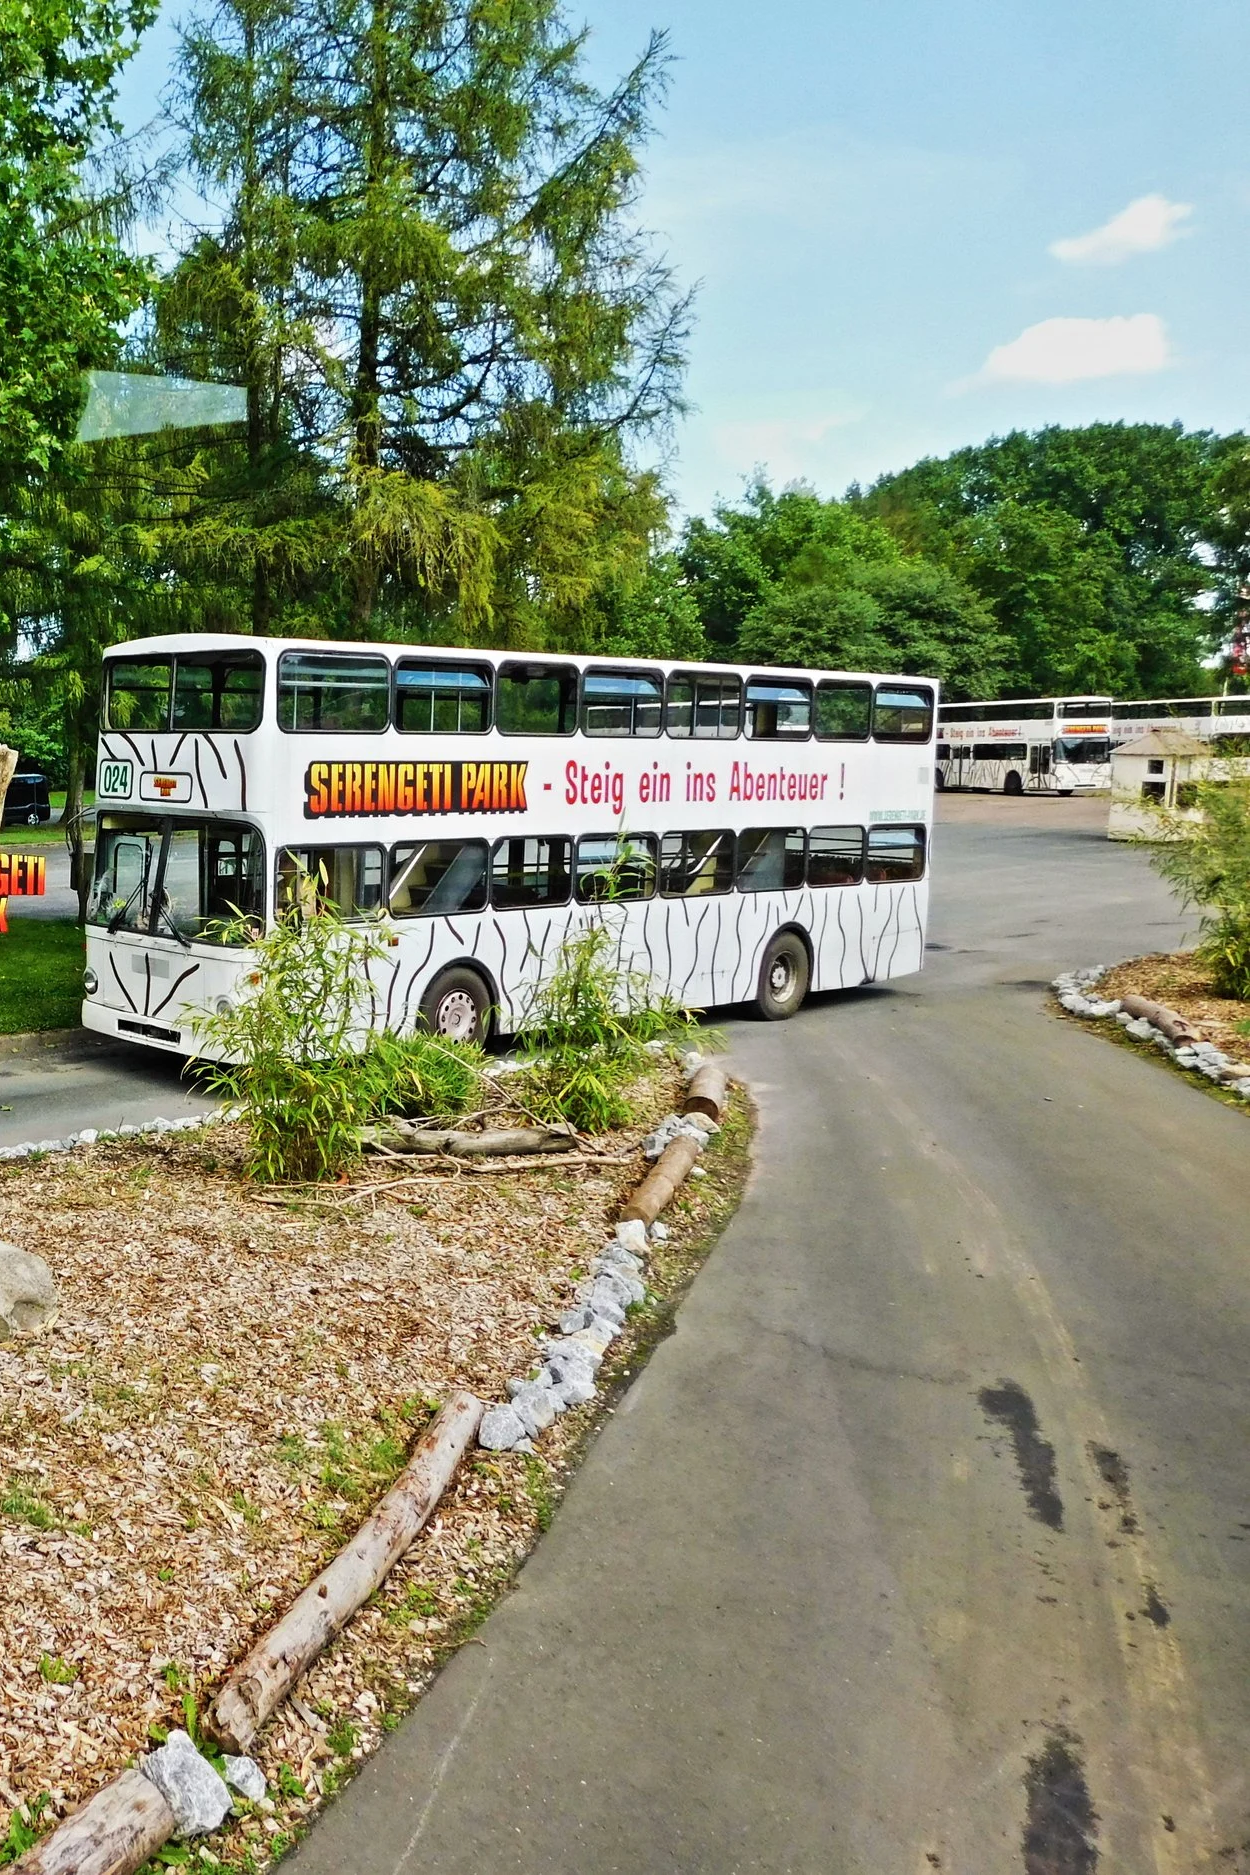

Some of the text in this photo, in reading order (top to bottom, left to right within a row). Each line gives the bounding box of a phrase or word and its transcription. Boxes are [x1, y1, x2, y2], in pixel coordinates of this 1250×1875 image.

[104, 765, 128, 793] 024
[308, 762, 452, 814] SERENGETI
[460, 762, 529, 810] PARK
[565, 760, 624, 815] Steig
[639, 761, 671, 803] ein
[686, 761, 716, 802] ins
